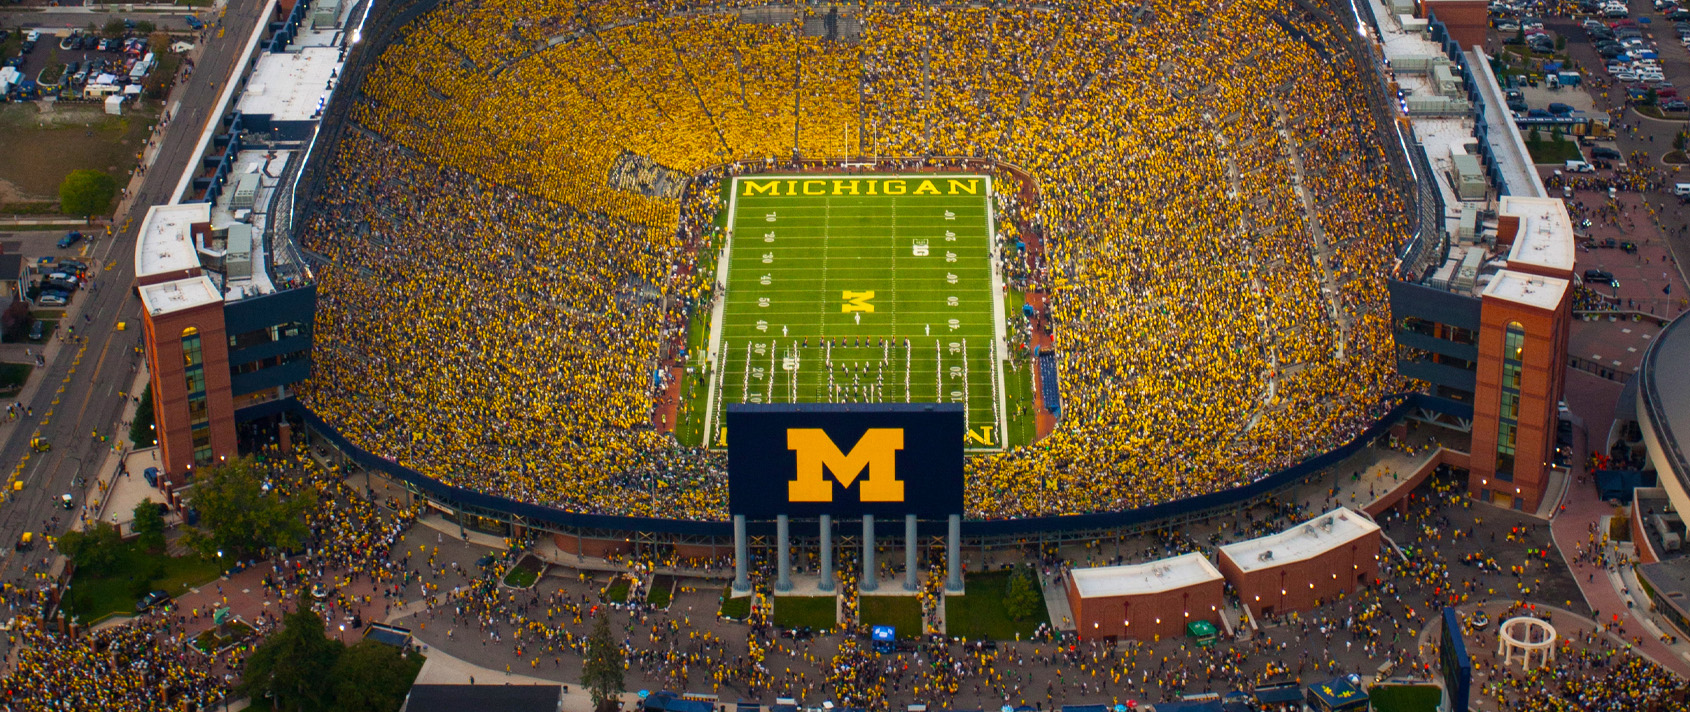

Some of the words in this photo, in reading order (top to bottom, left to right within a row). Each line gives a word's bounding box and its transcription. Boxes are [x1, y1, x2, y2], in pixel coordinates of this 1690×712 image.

[743, 180, 979, 196] MICHIGAN
[842, 290, 875, 313] M
[787, 428, 904, 502] M
